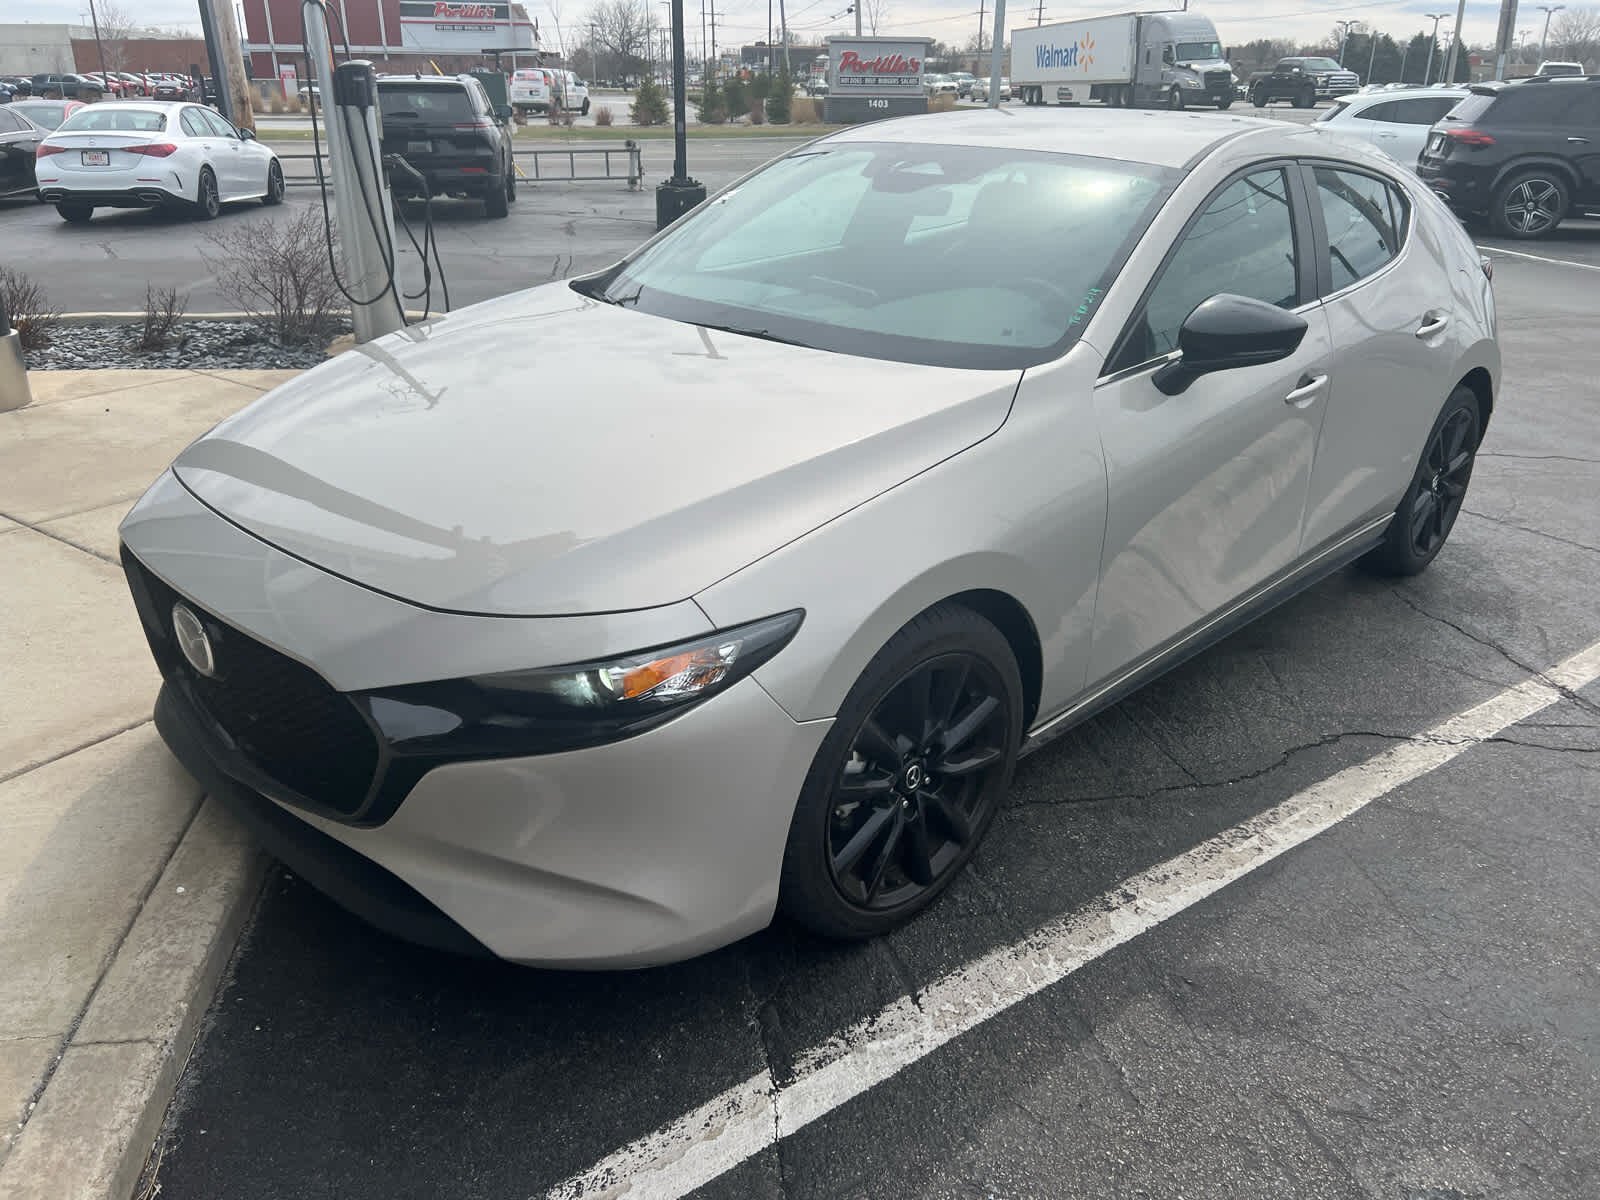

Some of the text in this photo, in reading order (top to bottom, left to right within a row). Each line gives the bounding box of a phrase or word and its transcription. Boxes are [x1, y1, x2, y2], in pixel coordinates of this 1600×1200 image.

[433, 2, 496, 18] Portillo's
[839, 50, 921, 73] Portillo's
[1036, 40, 1078, 69] Walmart
[868, 99, 889, 108] 1403
